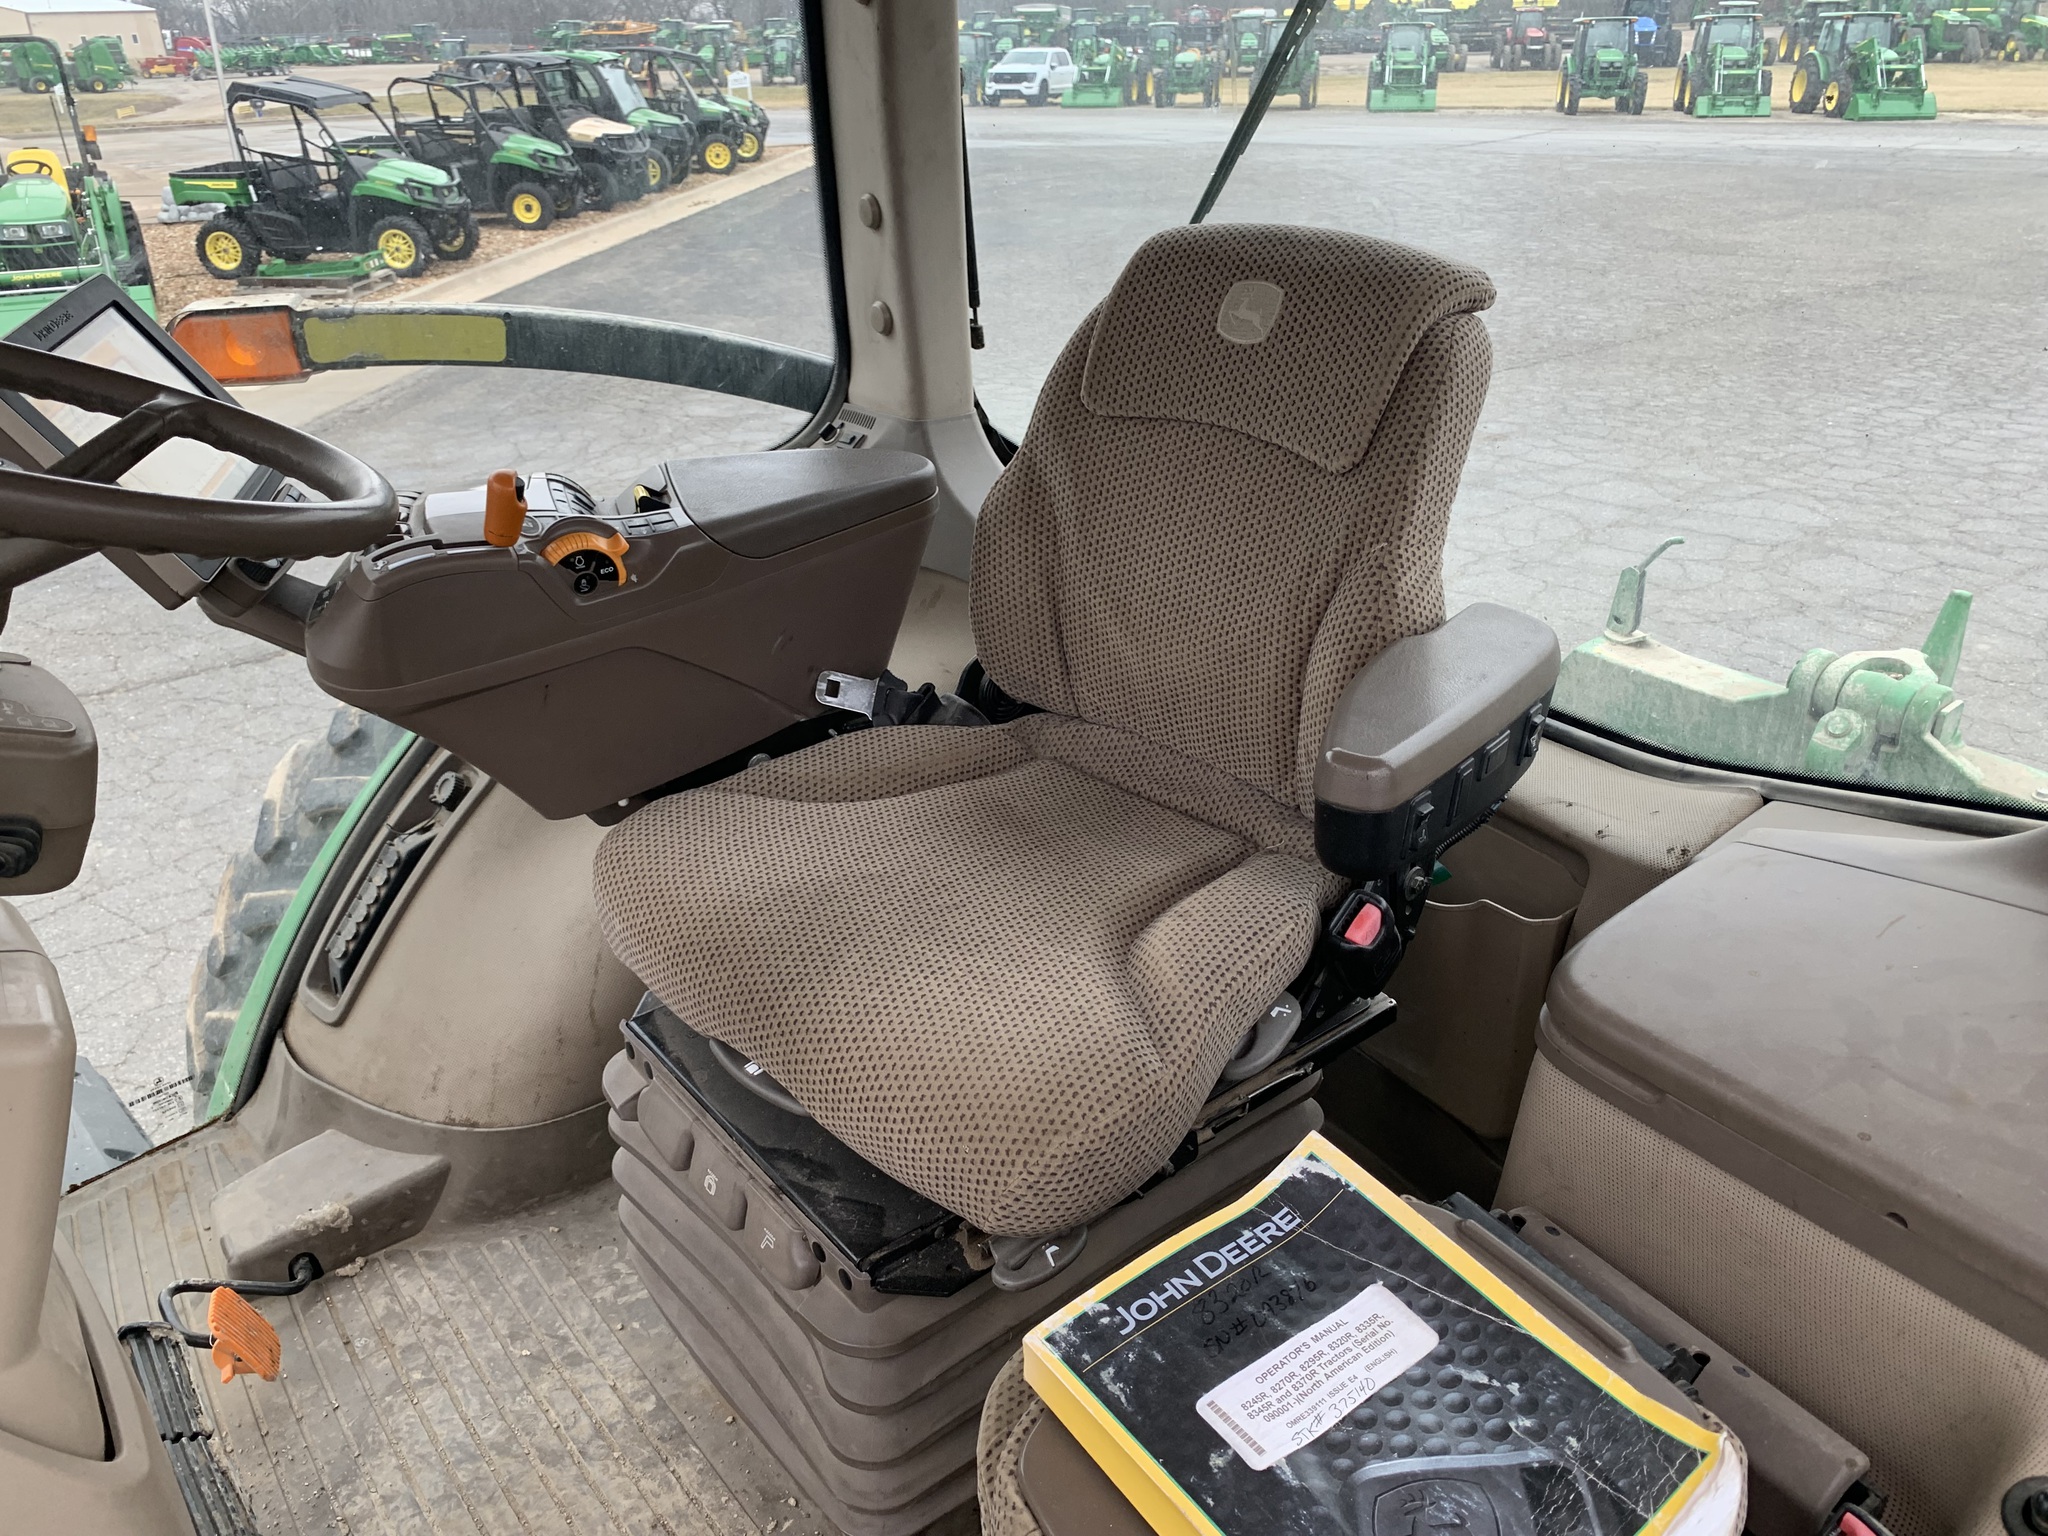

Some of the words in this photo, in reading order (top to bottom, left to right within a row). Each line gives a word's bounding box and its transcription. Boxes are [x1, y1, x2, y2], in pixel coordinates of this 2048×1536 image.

[600, 566, 614, 575] ECO
[1116, 1268, 1203, 1336] JOHN
[1192, 1206, 1302, 1280] DEERE
[1192, 1265, 1272, 1325] 8320R
[1240, 1391, 1273, 1411] 8245R,
[1270, 1371, 1302, 1394] 8270R,
[1299, 1349, 1331, 1372] 8295R,
[1327, 1331, 1358, 1352] 8320R,
[1355, 1313, 1385, 1333] 8335R,
[1247, 1399, 1276, 1420] 8345R
[1276, 1389, 1293, 1405] and
[1291, 1369, 1319, 1392] 8370R
[1317, 1346, 1353, 1371] Tractors
[1351, 1328, 1379, 1349] (Serial
[1377, 1320, 1394, 1331] No.
[1255, 1341, 1311, 1384] OPERATOR'S
[1310, 1319, 1349, 1344] MANUAL
[1323, 1352, 1363, 1381] American
[1361, 1330, 1395, 1354] Edition)
[1286, 1397, 1328, 1429] OMRE339111
[1326, 1381, 1349, 1399] ISSUE
[1347, 1374, 1359, 1384] E4
[1364, 1348, 1398, 1373] (ENGLISH)
